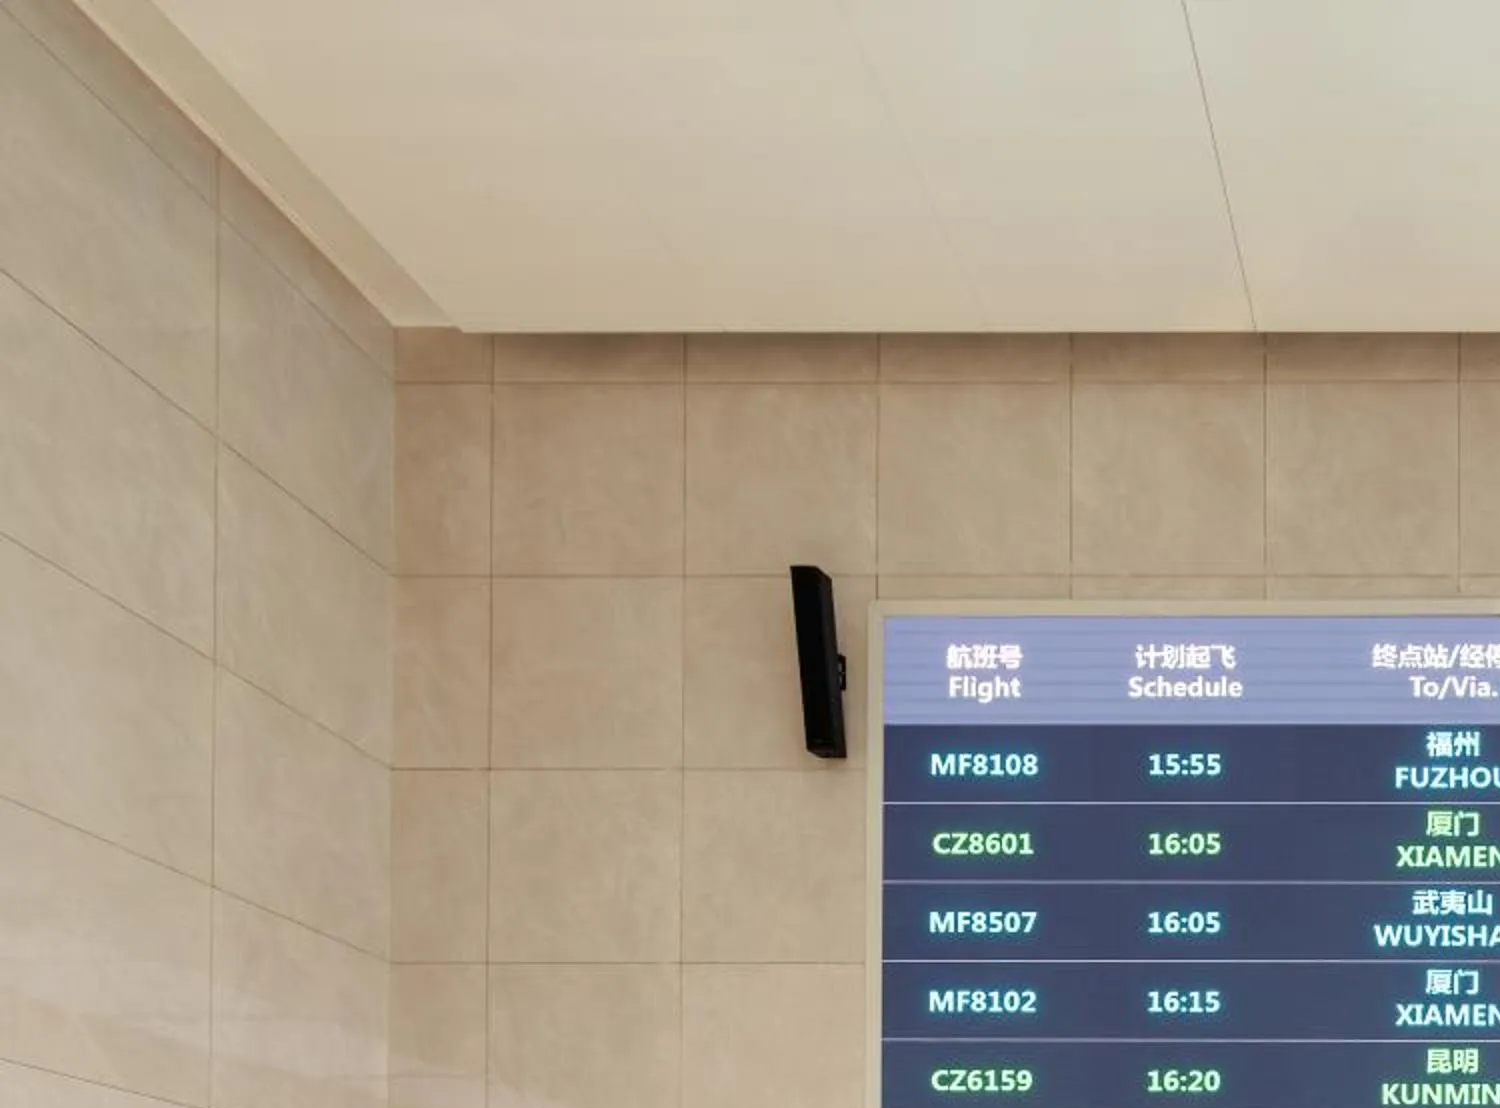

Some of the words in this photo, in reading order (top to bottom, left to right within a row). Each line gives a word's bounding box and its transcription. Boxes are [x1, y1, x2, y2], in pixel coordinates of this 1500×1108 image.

[946, 644, 1023, 669] 航班号
[1135, 643, 1237, 669] 计划起飞
[949, 675, 1021, 704] Flight
[1128, 675, 1243, 698] Schedule
[1409, 675, 1498, 700] To/Via.
[1426, 731, 1480, 758] 福州
[931, 753, 1038, 776] MF8108
[1149, 753, 1221, 776] 15:55
[1425, 810, 1480, 837] 厦门
[932, 832, 1034, 855] CZ8601
[1149, 833, 1221, 855] 16:05
[1412, 889, 1493, 916] 武夷山
[929, 911, 1037, 933] MF8507
[1148, 911, 1221, 934] 16:05
[1425, 969, 1479, 995] 厦门
[929, 990, 1037, 1013] MF8102
[1148, 991, 1221, 1013] 16:15
[1426, 1048, 1479, 1074] 昆明
[931, 1069, 1033, 1091] CZ6159
[1147, 1069, 1221, 1092] 16:20
